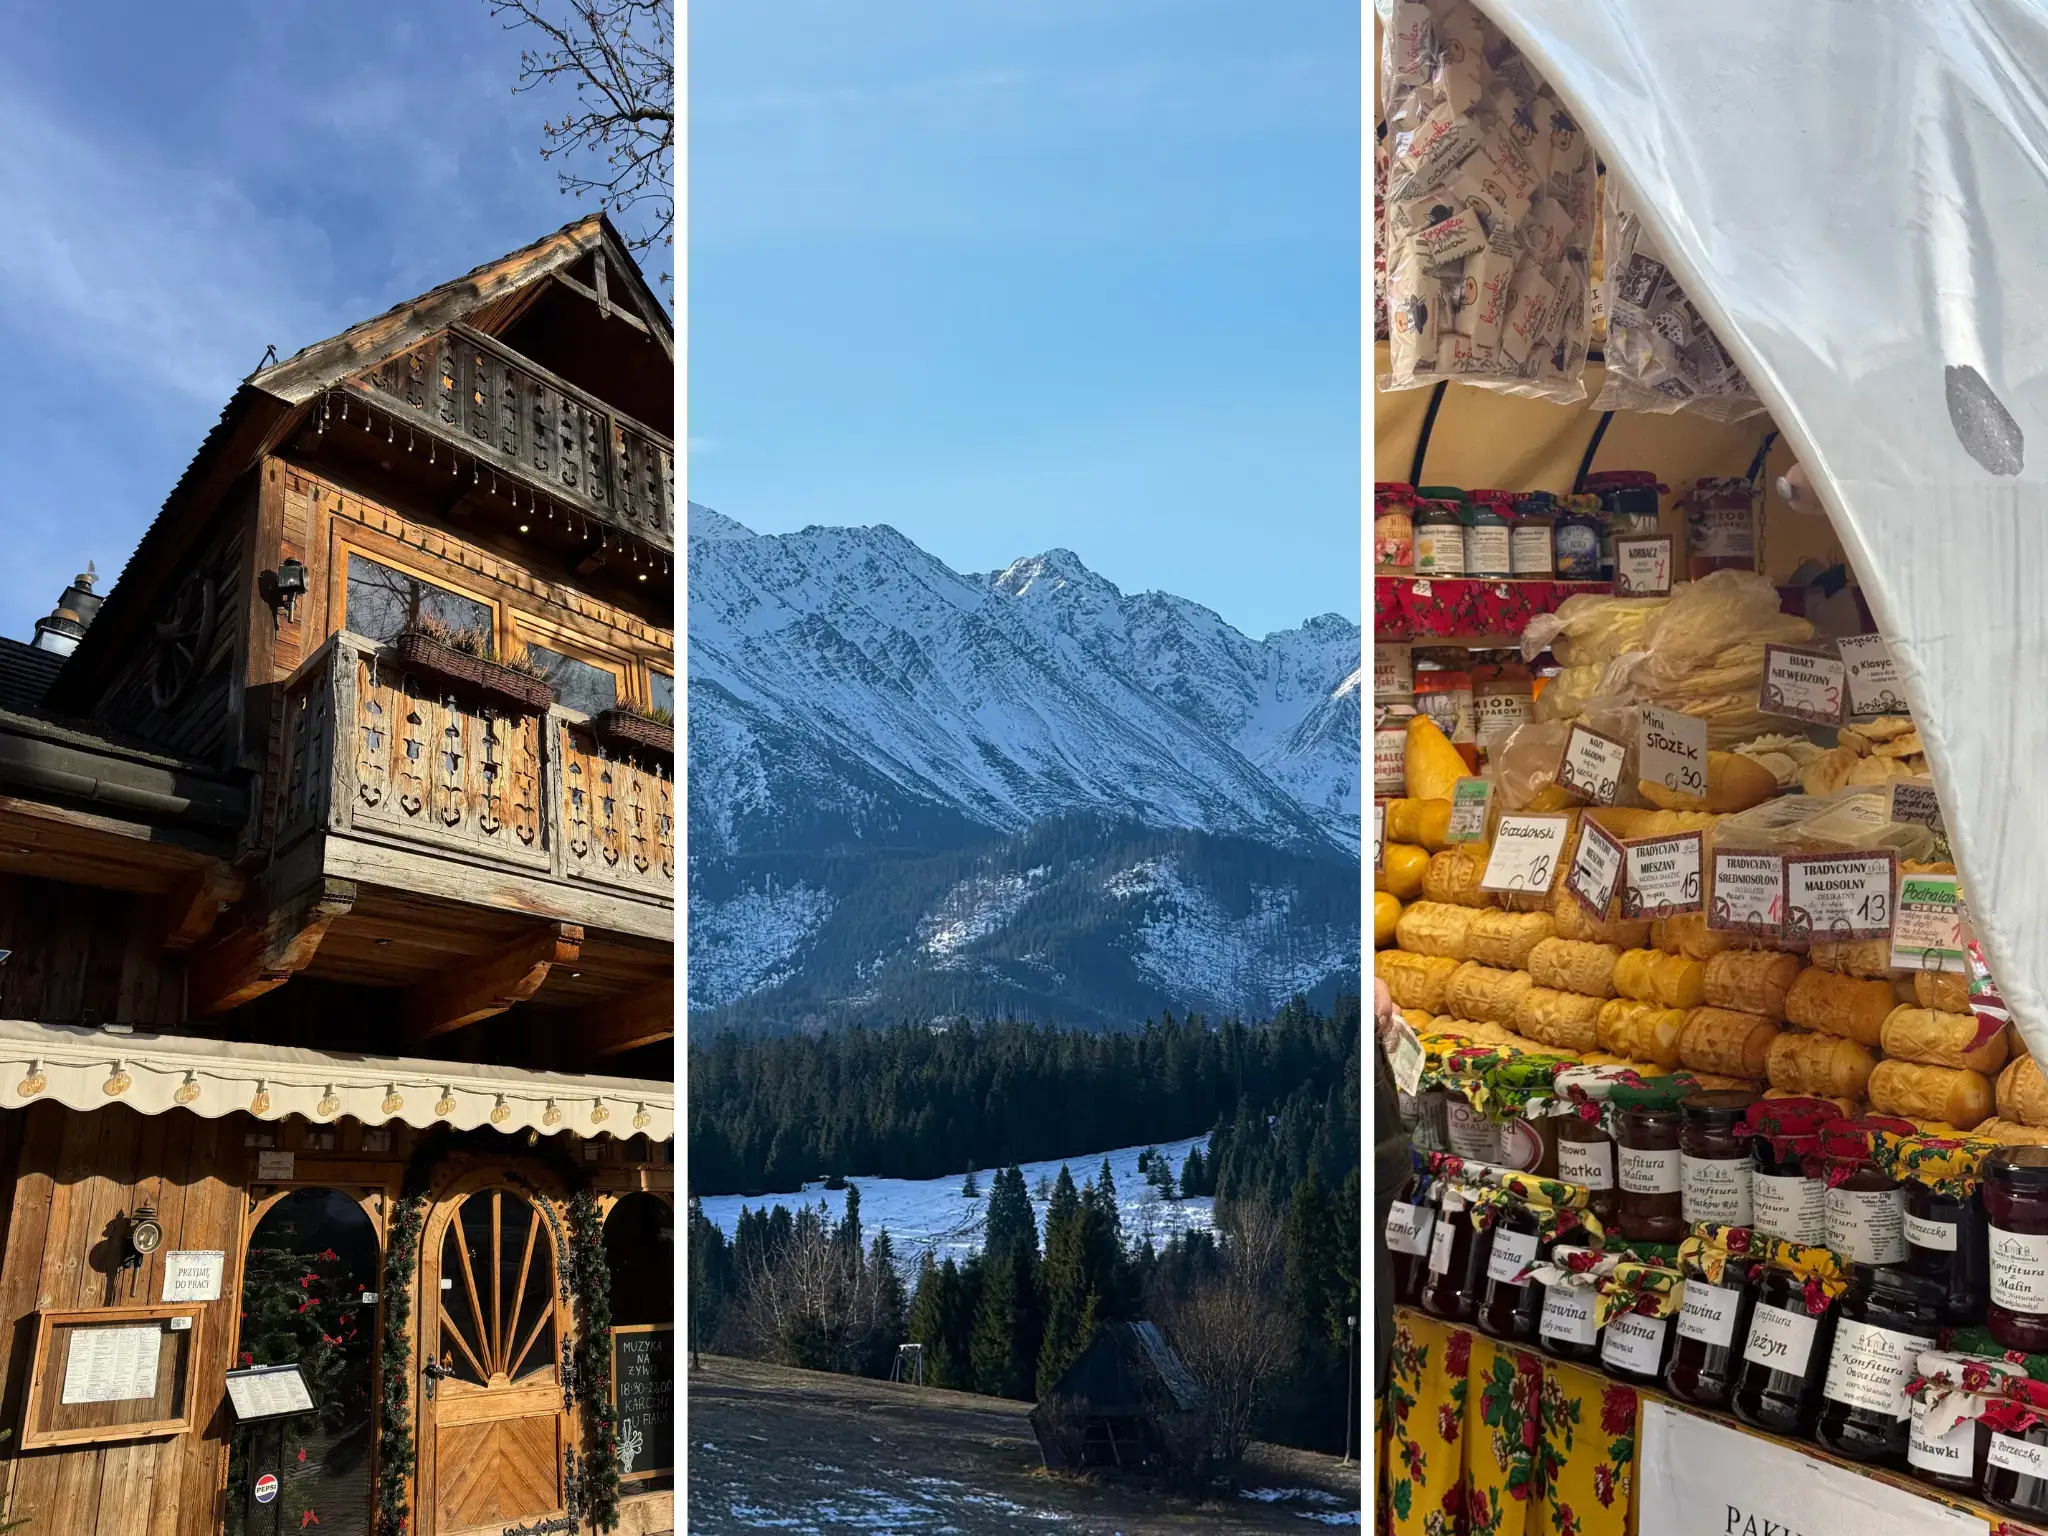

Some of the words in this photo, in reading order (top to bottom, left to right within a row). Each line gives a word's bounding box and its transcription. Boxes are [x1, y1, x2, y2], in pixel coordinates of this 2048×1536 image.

[1427, 137, 1476, 185] GÓRALSKA
[1479, 271, 1501, 325] krówka
[1547, 275, 1570, 332] GÓRALSKA
[1454, 340, 1473, 359] kró
[1789, 655, 1816, 669] BIAŁY
[1860, 659, 1893, 670] Klasyc
[1771, 668, 1832, 687] NIEWĘDZONY
[1472, 696, 1515, 709] MIÓD
[1823, 686, 1839, 715] 3
[1475, 708, 1523, 717] ZEPAKOWY
[1642, 709, 1665, 731] Mini
[1589, 737, 1604, 750] KOZI
[1500, 820, 1557, 839] Gazdowski
[1636, 842, 1680, 859] TRADYCYJNY
[1640, 859, 1676, 874] MIESZANY
[1726, 858, 1772, 870] TRADYCYJNY
[1803, 863, 1867, 876] TRADYCYJNY
[1680, 871, 1701, 899] 15
[1804, 879, 1866, 892] MAŁOSOLNY
[1856, 894, 1886, 922] 13
[1910, 903, 1954, 914] CENA
[1622, 1168, 1655, 1182] Malina
[1687, 1184, 1738, 1196] Konfitura
[177, 1267, 211, 1279] PRZYJMĘ
[1991, 1257, 2045, 1277] Konfitura
[175, 1280, 187, 1289] DO
[187, 1280, 211, 1290] PRACY
[1998, 1277, 2033, 1293] Malin
[623, 1341, 662, 1353] MUZYKA
[1748, 1329, 1788, 1357] Jeżyn
[637, 1353, 650, 1364] NA
[1841, 1353, 1904, 1376] Konfitura
[1846, 1366, 1869, 1381] Owoce
[1869, 1373, 1892, 1386] Leśne
[631, 1415, 640, 1428] U
[1997, 1440, 2042, 1463] Porzeczka
[256, 1481, 277, 1494] PEPSI
[1725, 1504, 1803, 1536] PAK
